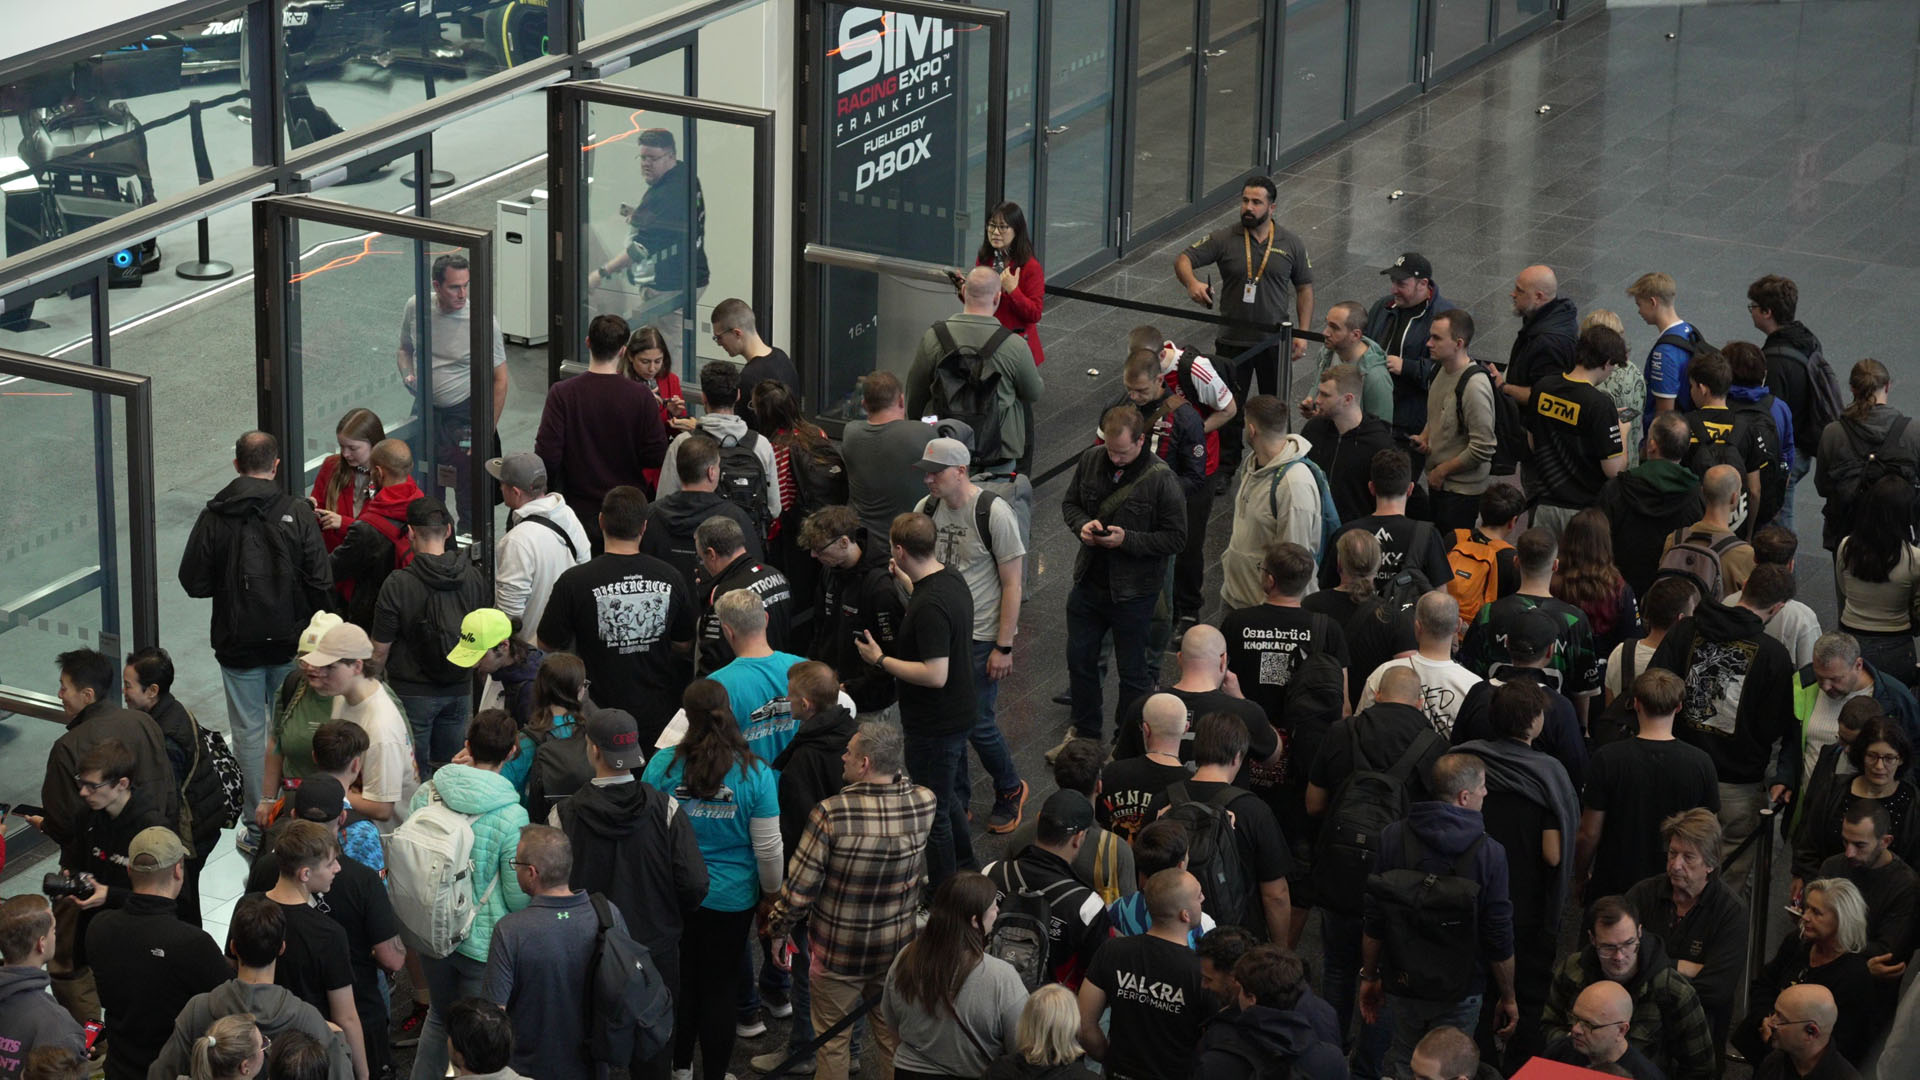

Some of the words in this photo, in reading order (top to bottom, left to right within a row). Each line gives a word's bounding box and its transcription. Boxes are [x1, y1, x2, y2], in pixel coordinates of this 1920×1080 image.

[836, 76, 951, 137] FRANKFURT
[837, 76, 898, 117] RACING
[863, 124, 910, 156] FUELLED
[911, 116, 926, 132] BY
[855, 132, 933, 192] D-BOX
[1540, 398, 1576, 421] DTM
